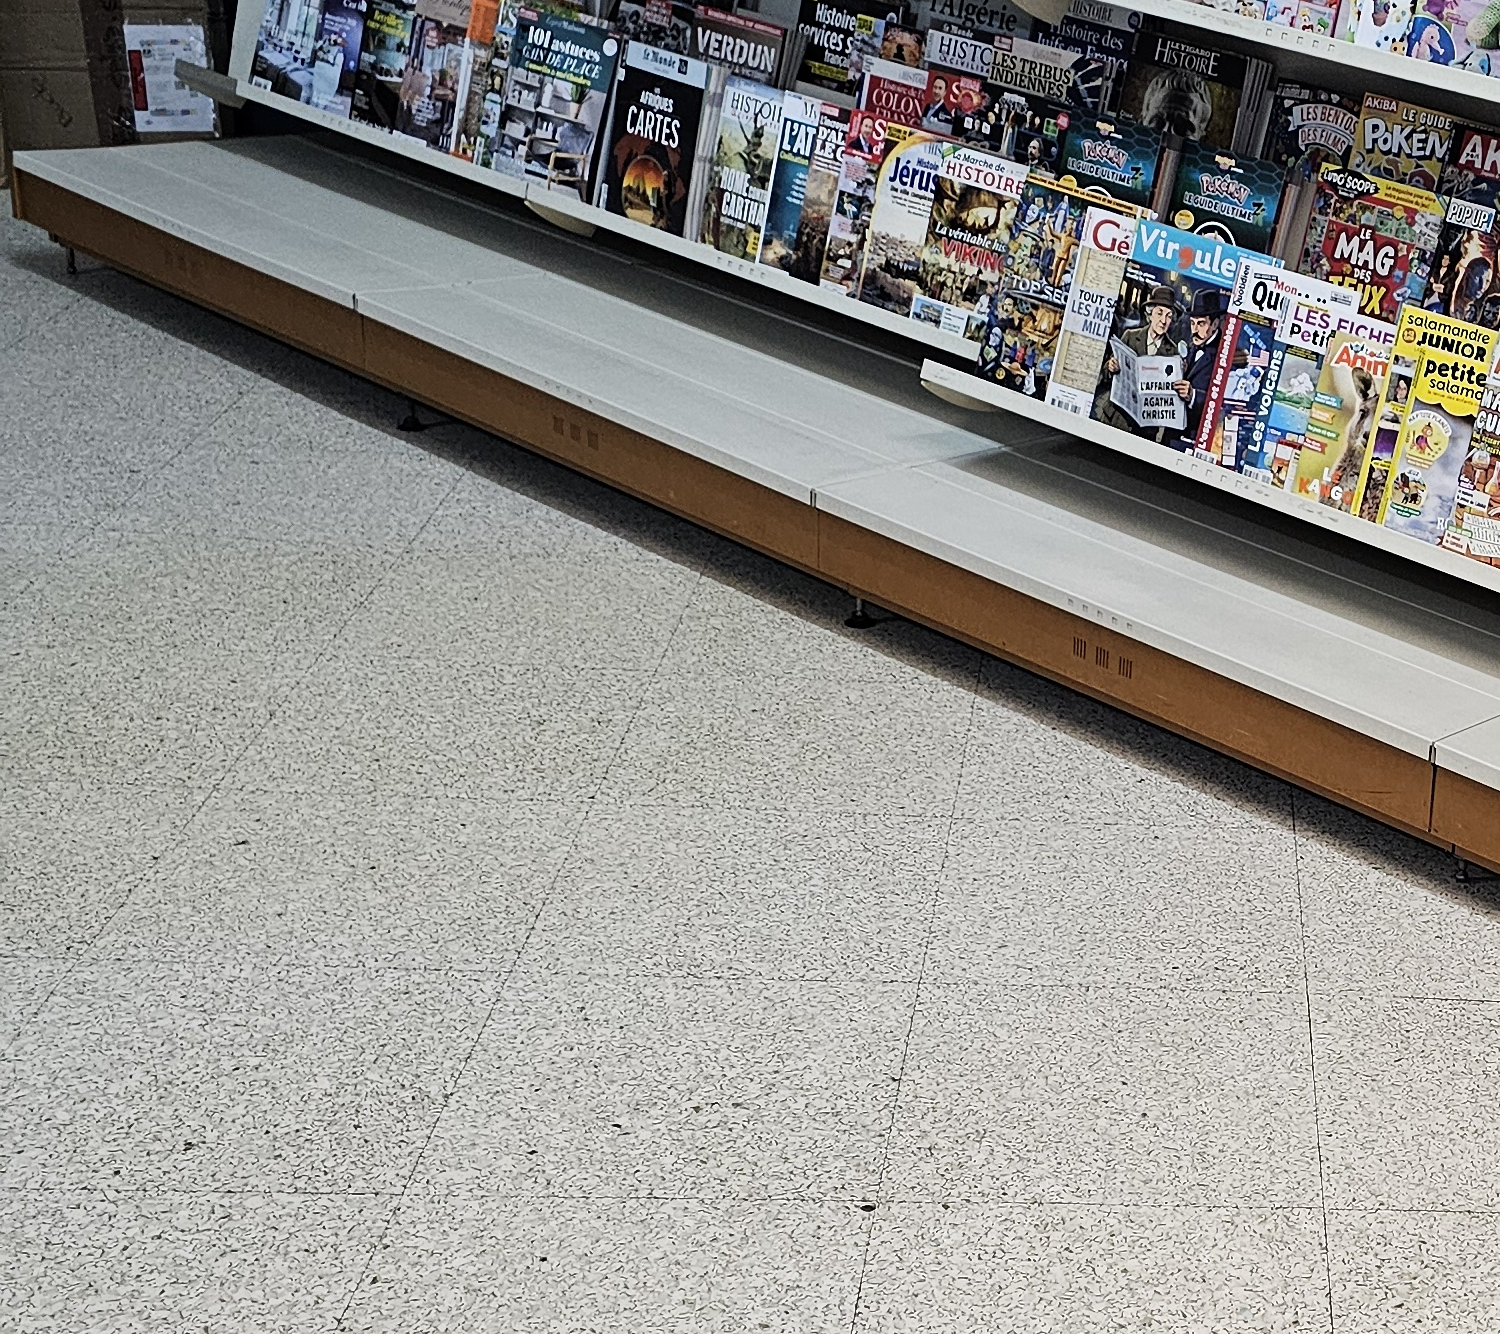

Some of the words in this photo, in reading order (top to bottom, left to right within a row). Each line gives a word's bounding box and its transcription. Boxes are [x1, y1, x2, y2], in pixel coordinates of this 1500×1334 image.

[551, 38, 601, 63] astuces
[697, 26, 777, 72] VERDUN
[988, 71, 1066, 99] INDIENNES
[1019, 56, 1072, 87] TRIBUS
[626, 107, 681, 150] CARTES
[1139, 226, 1238, 280] Virgule
[1333, 230, 1396, 272] MAG
[1405, 313, 1491, 345] salamandre
[1415, 334, 1487, 363] JUNIOR
[1140, 379, 1174, 392] L'AFFAIRE
[1258, 348, 1284, 417] volcans
[1423, 359, 1488, 392] petite
[1141, 408, 1176, 422] CHRISTIE
[1143, 396, 1174, 409] AGATHA
